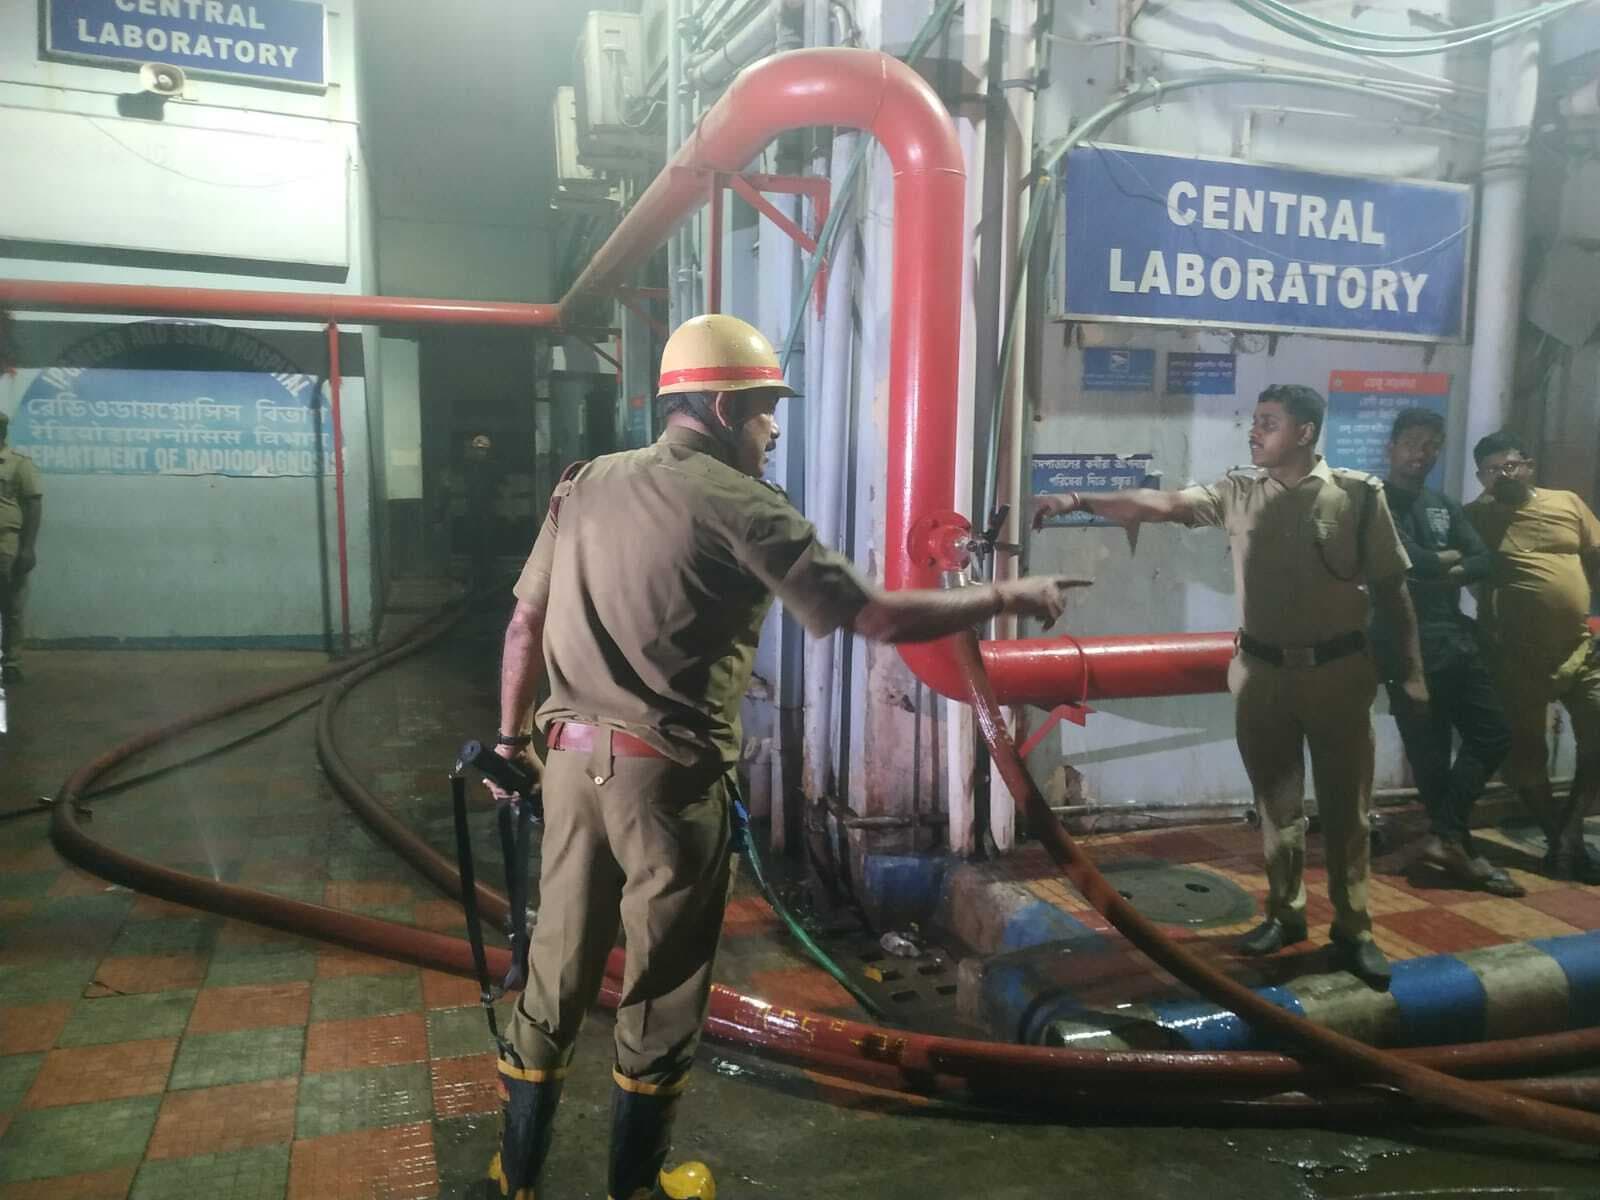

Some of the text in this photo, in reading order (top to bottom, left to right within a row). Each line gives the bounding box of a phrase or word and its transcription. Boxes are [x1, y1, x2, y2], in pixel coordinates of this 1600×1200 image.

[116, 0, 266, 30] CENTRAL
[77, 18, 299, 68] LABORATORY
[1166, 180, 1386, 246] CENTRAL
[1108, 247, 1429, 313] LABORATORY
[155, 447, 179, 471] OF
[187, 448, 342, 474] RADIODIAGNOIS
